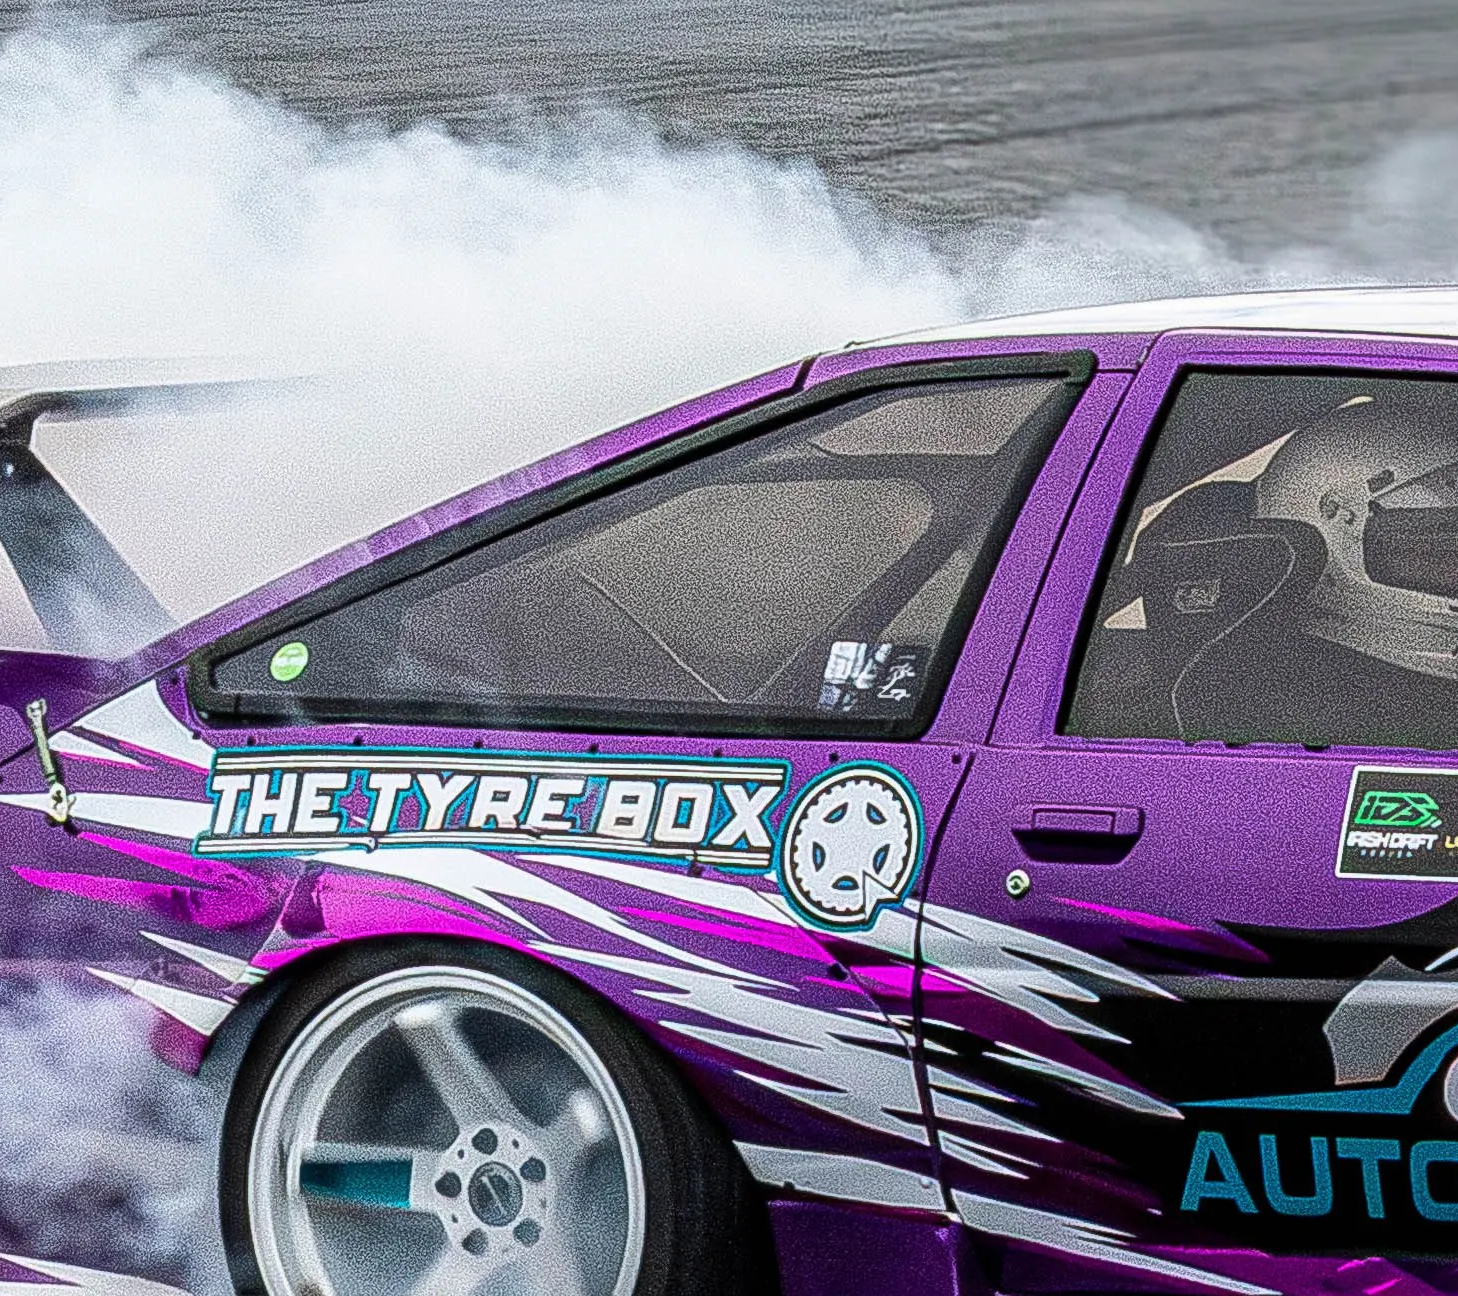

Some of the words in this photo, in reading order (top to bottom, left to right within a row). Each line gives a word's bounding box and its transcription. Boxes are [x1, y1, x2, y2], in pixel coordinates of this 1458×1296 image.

[212, 770, 346, 834] THE
[368, 772, 584, 839] TYRE
[597, 781, 782, 850] BOX
